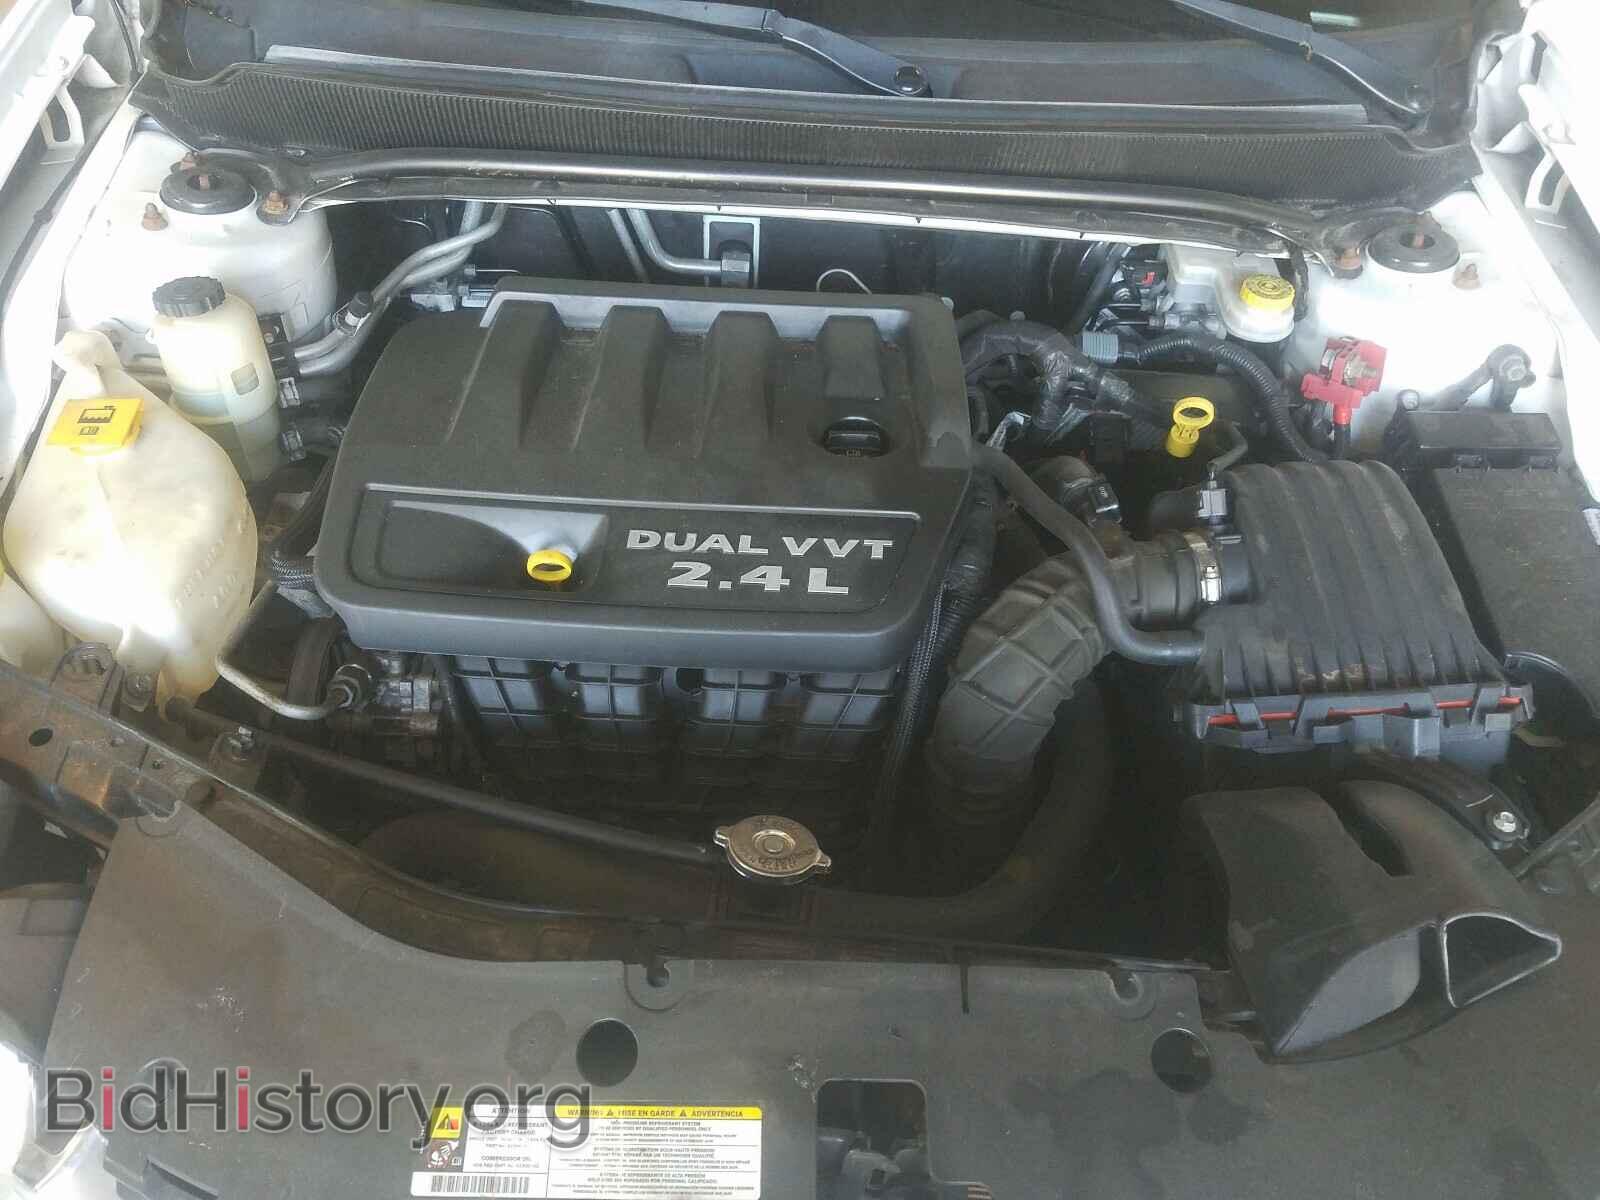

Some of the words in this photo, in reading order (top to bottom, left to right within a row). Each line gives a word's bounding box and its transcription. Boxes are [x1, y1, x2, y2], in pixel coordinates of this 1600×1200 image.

[626, 529, 769, 554] DUAL
[782, 537, 893, 559] VVT
[692, 1110, 743, 1118] ADVERTENCIA
